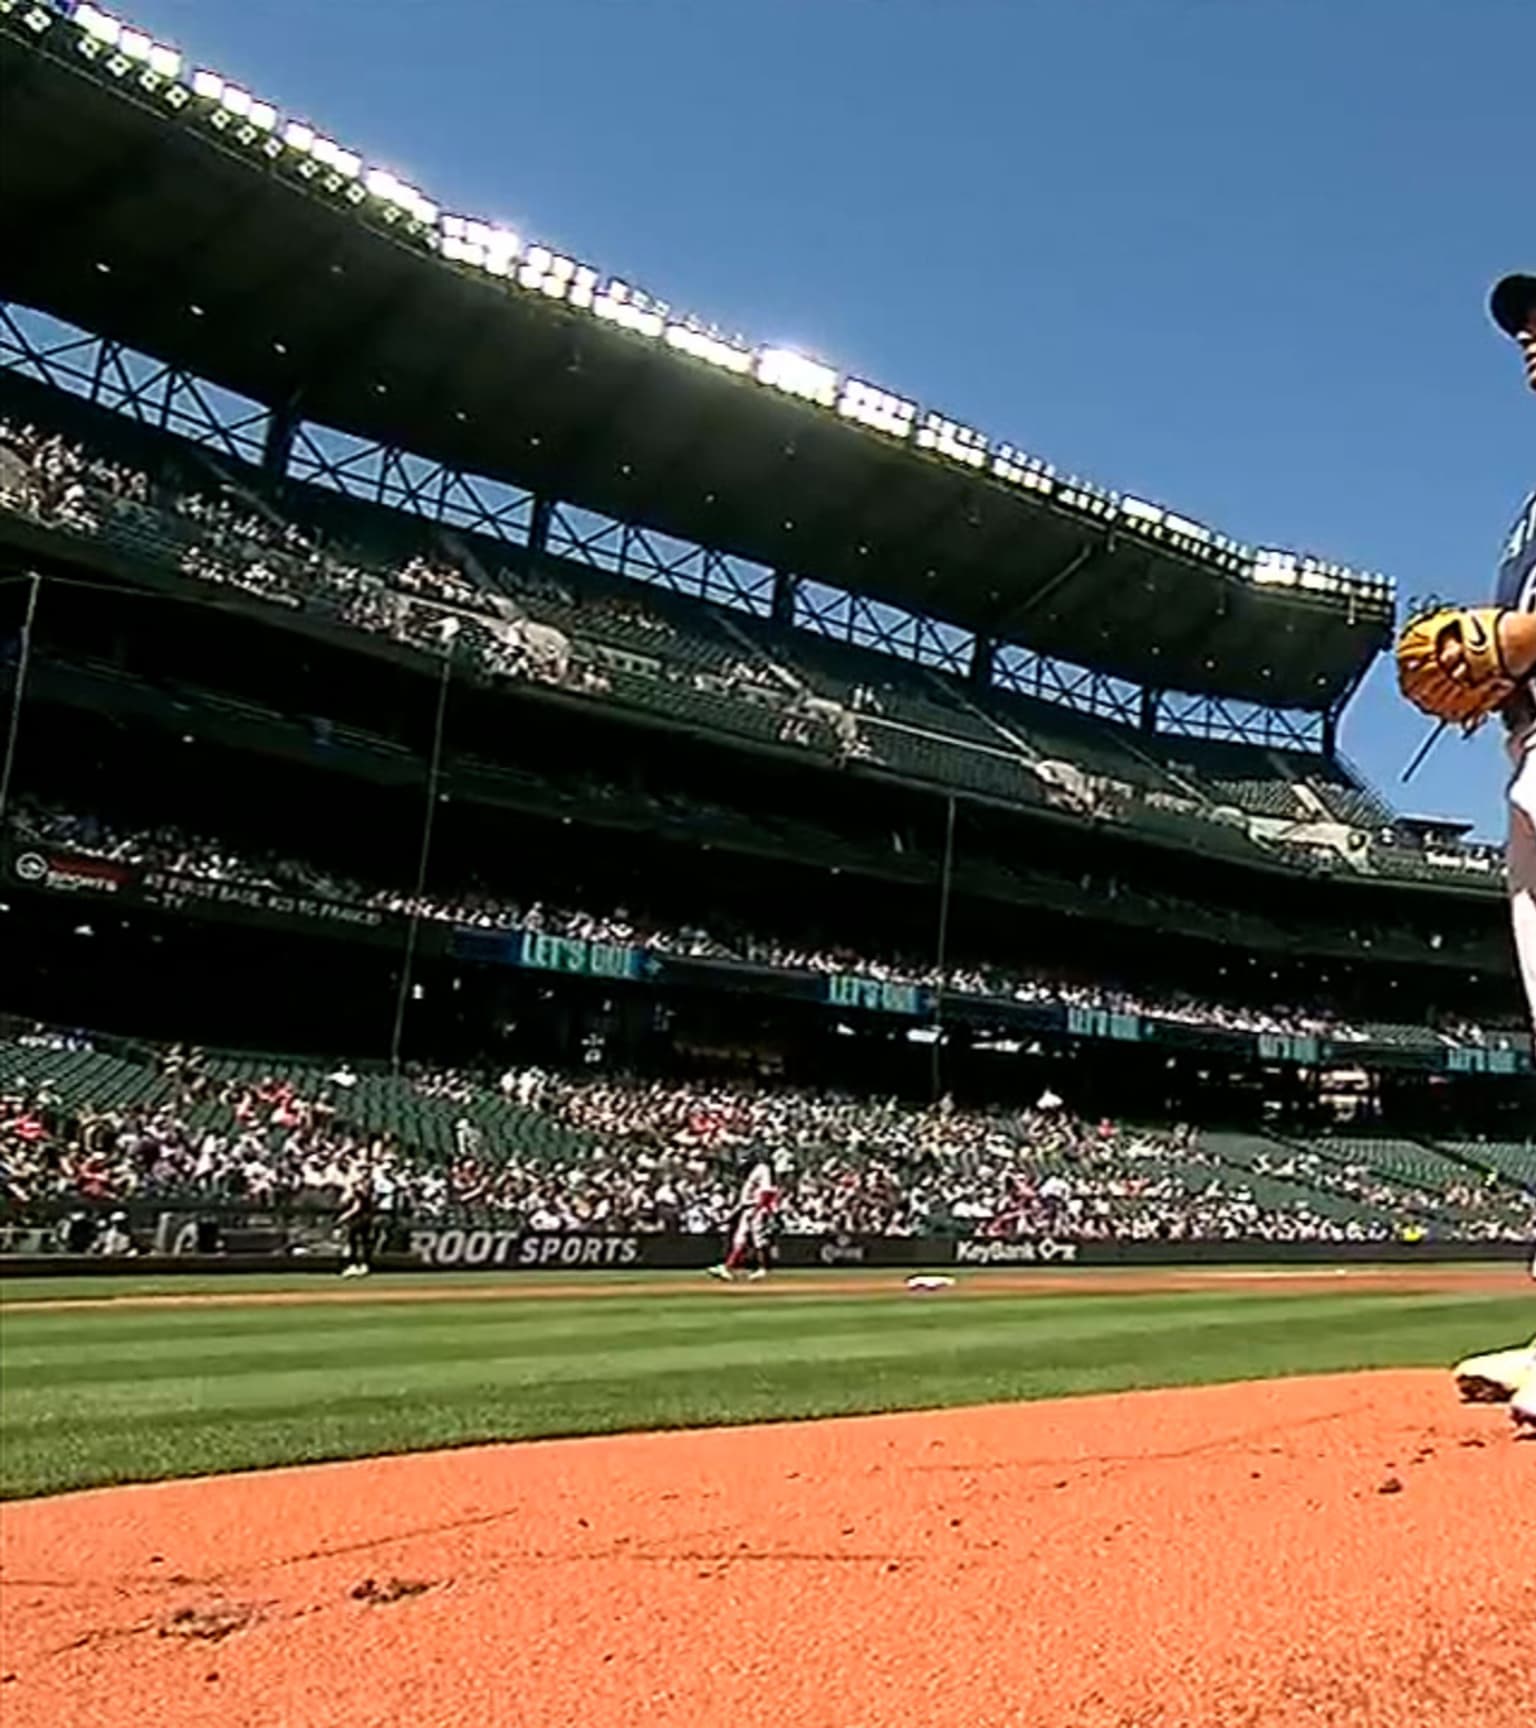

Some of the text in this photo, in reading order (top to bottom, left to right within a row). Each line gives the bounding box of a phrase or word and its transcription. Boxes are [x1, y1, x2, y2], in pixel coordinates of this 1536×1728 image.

[520, 933, 587, 971] LET'S
[409, 1230, 639, 1264] ROOT SPORTS
[956, 1239, 1036, 1263] KeyBank
